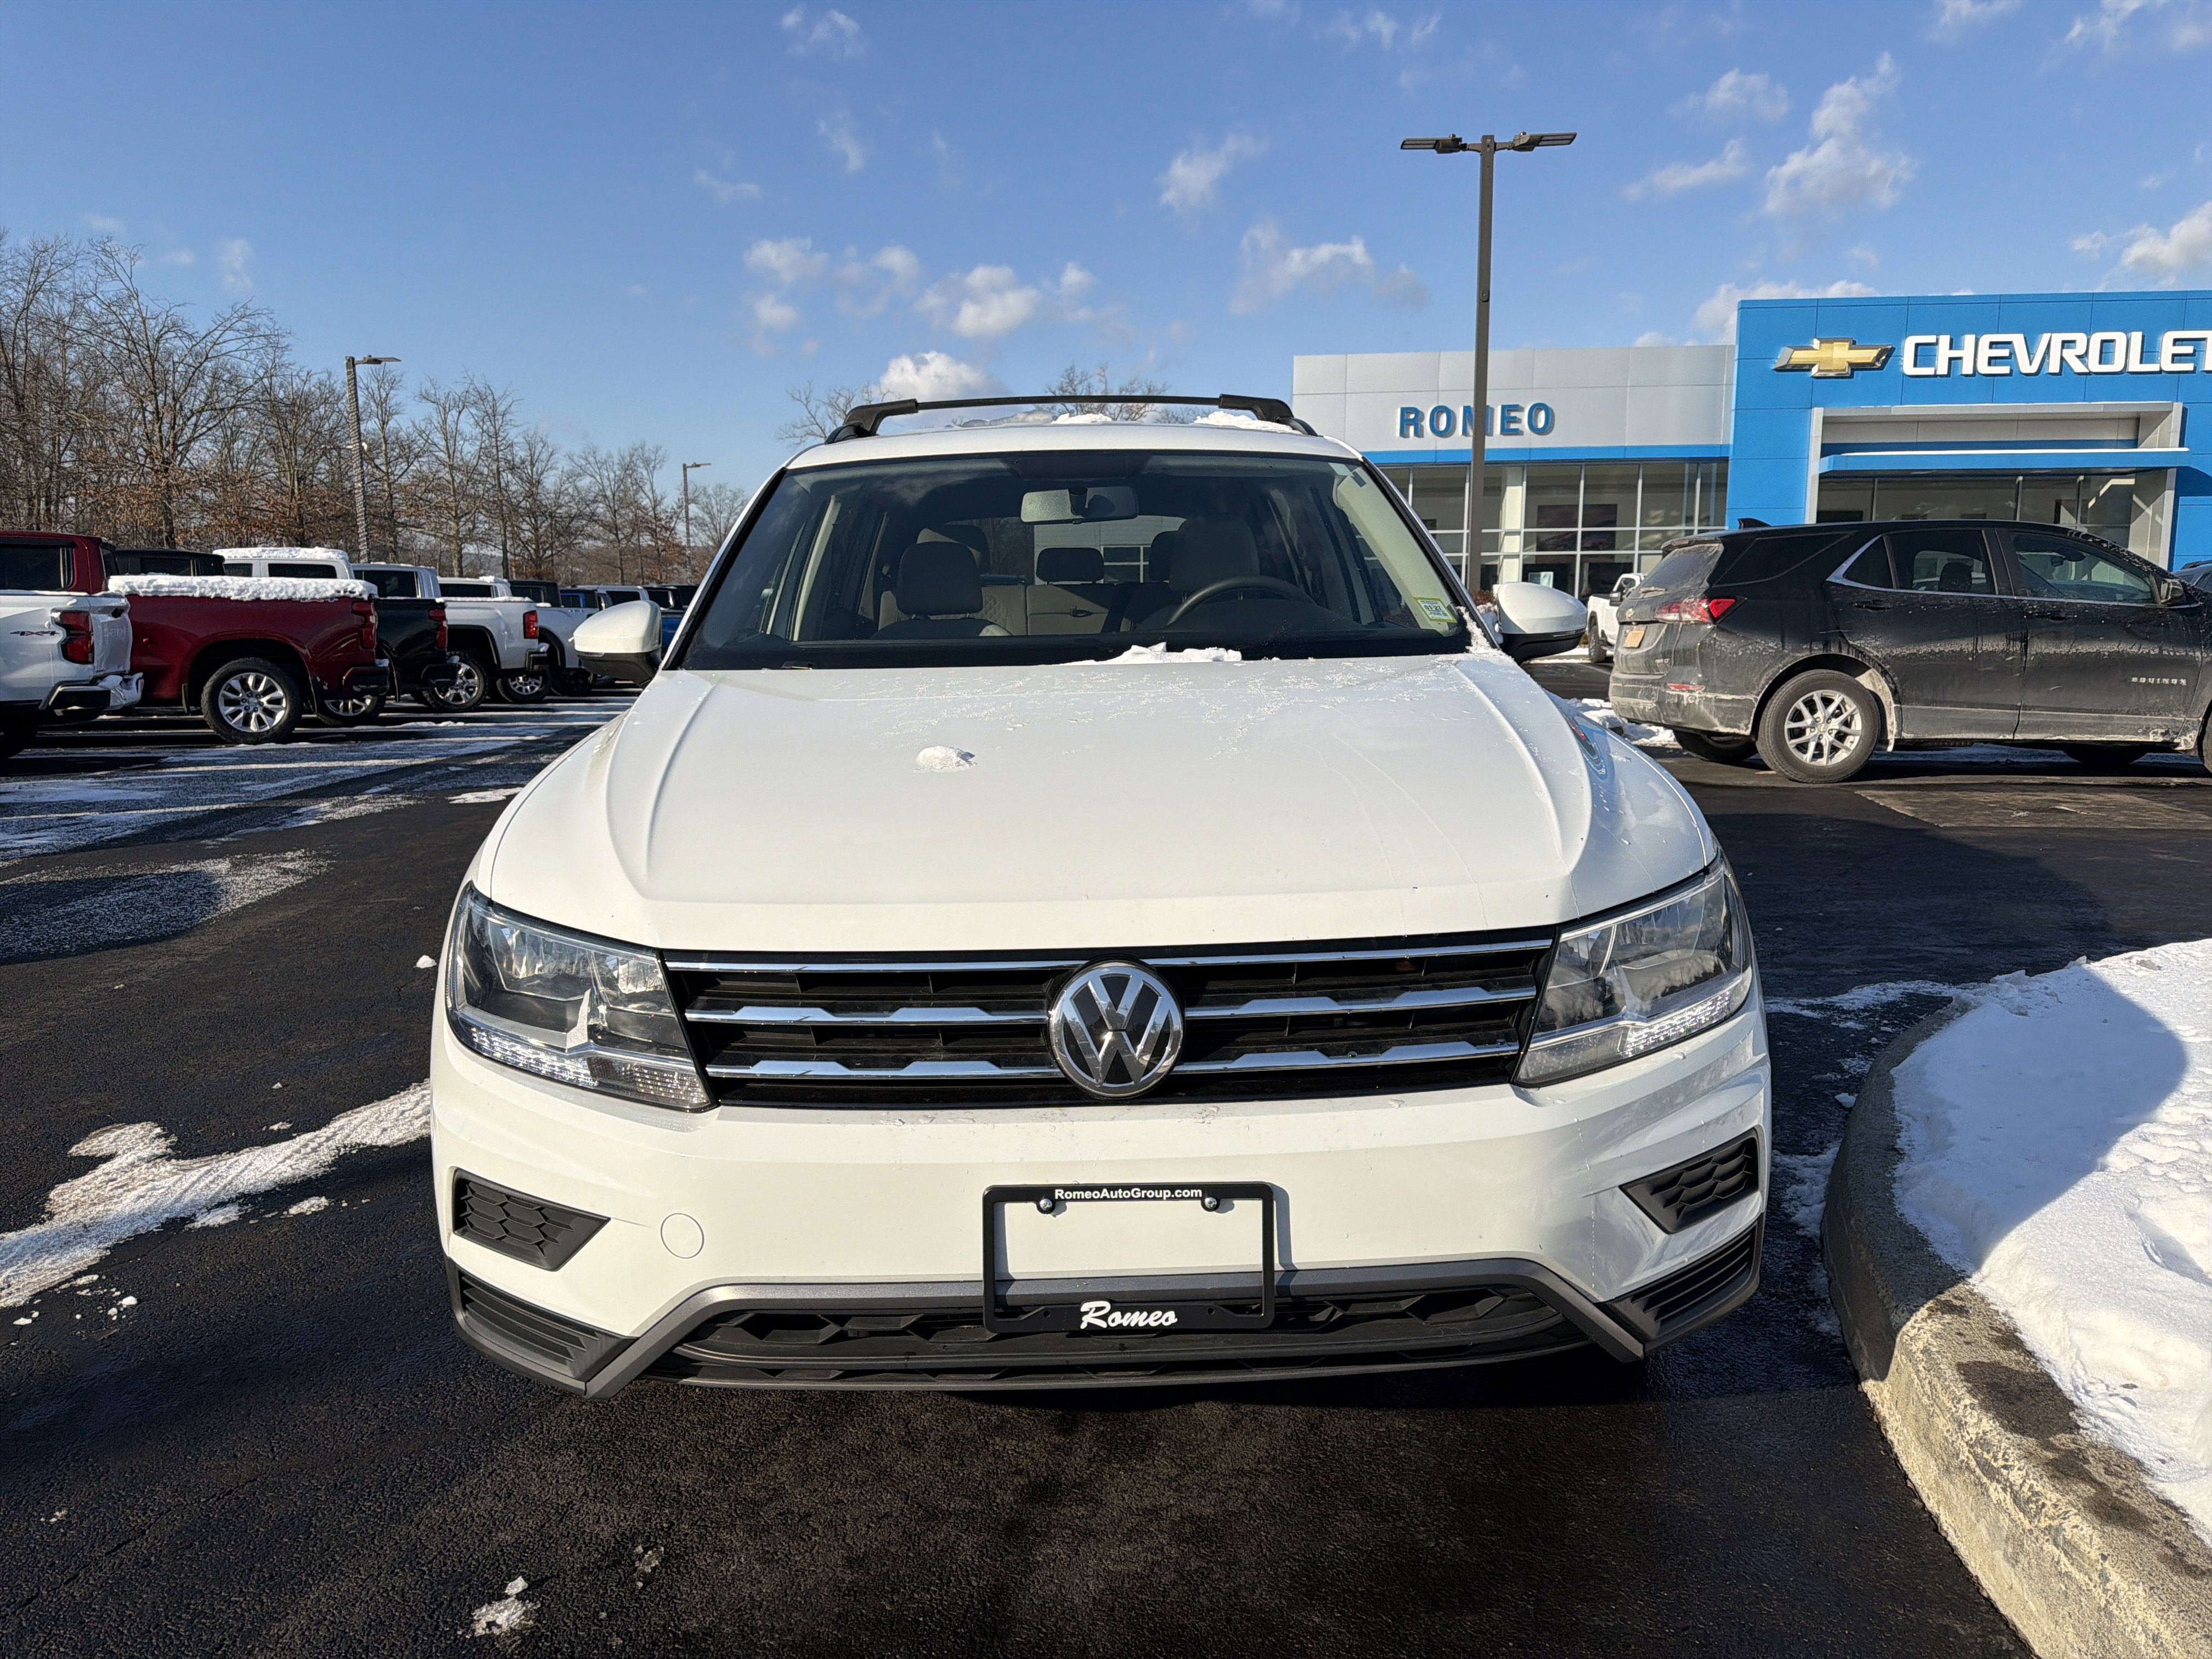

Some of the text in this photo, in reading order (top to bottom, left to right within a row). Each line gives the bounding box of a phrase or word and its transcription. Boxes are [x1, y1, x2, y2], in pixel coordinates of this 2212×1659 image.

[2131, 677, 2187, 685] EQUINOX
[1054, 1188, 1203, 1200] RomeoAutoGroup.com
[1080, 1300, 1178, 1329] Romeo
